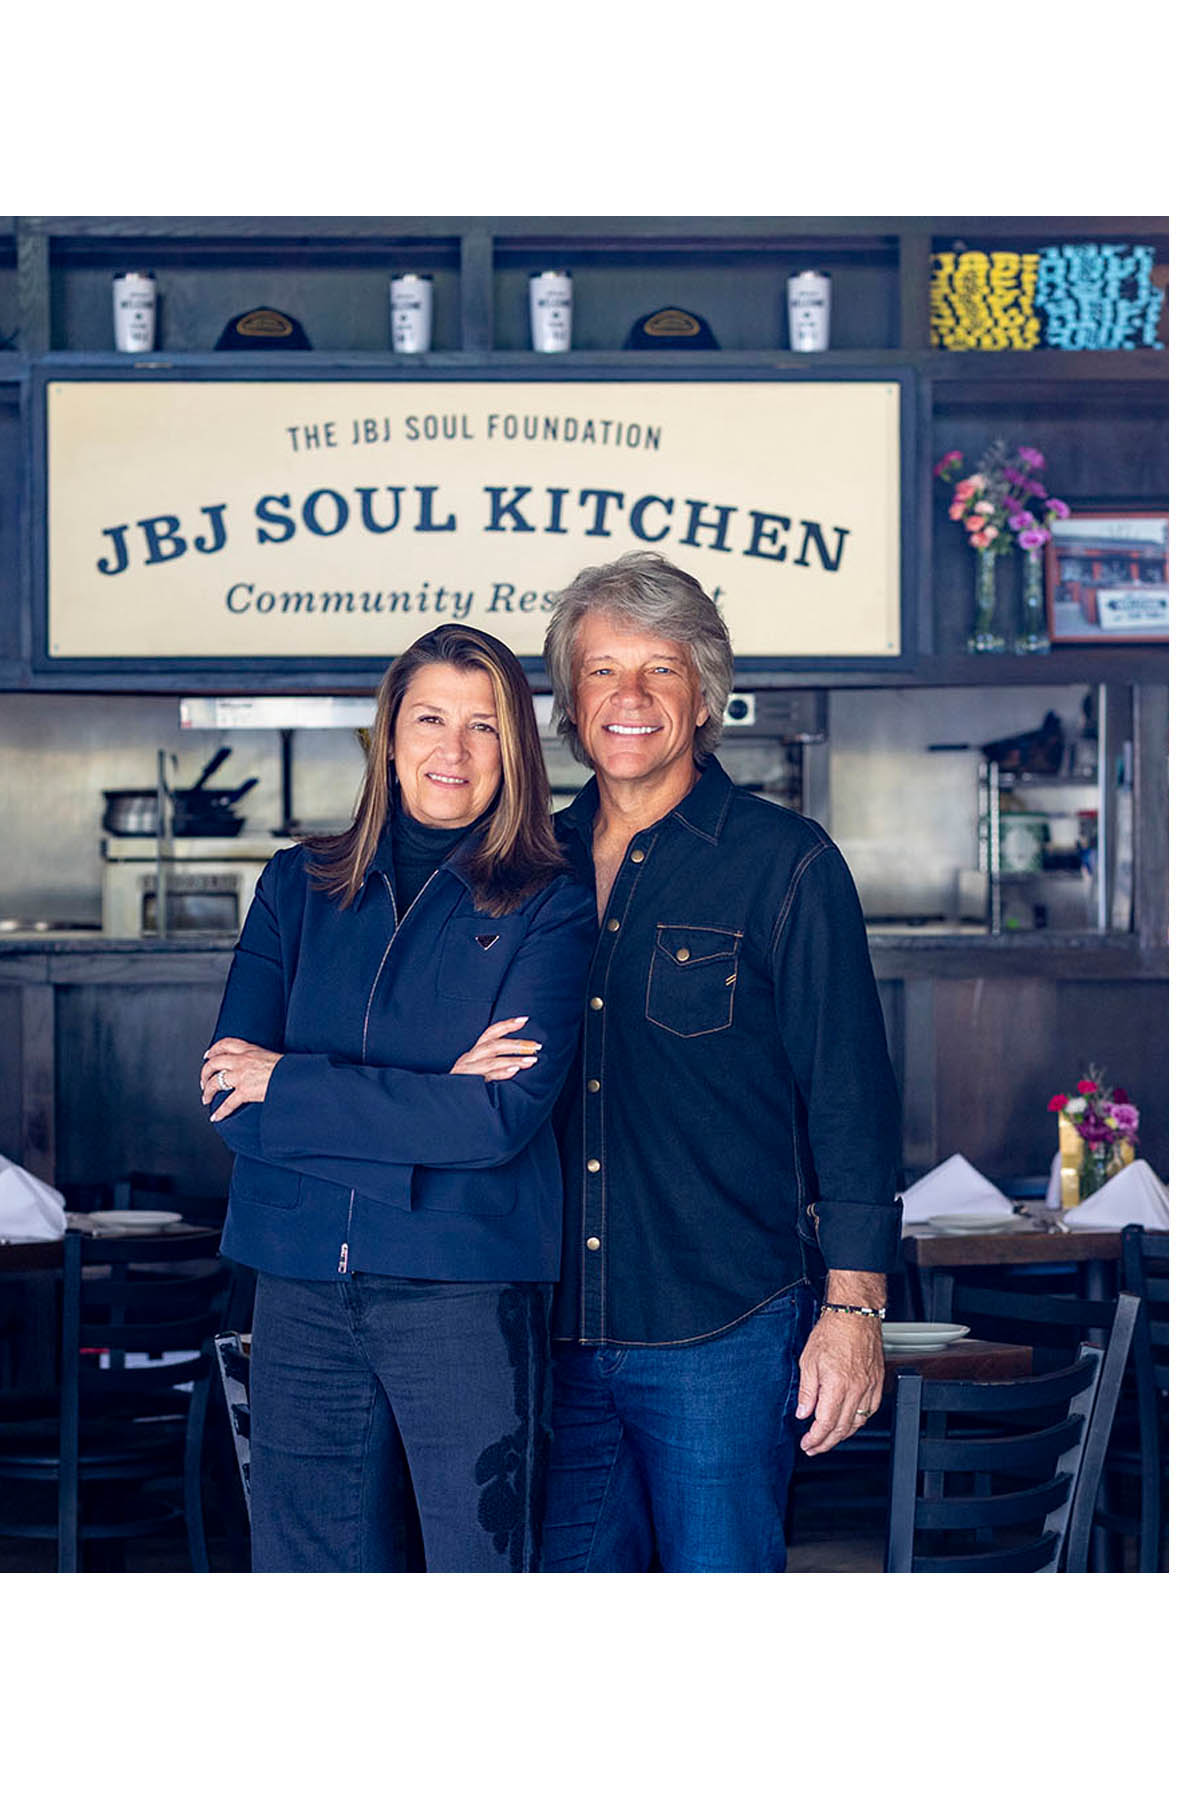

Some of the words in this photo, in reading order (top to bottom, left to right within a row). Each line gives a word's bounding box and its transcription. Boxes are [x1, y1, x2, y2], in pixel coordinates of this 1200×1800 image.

[287, 421, 338, 452] THE
[352, 417, 391, 445] JBJ
[405, 413, 474, 441] SOUL
[487, 413, 662, 451] FOUNDATION
[95, 502, 228, 577] JBJ
[254, 485, 458, 545] SOUL
[482, 485, 851, 573] KITCHEN
[225, 582, 474, 620] Community
